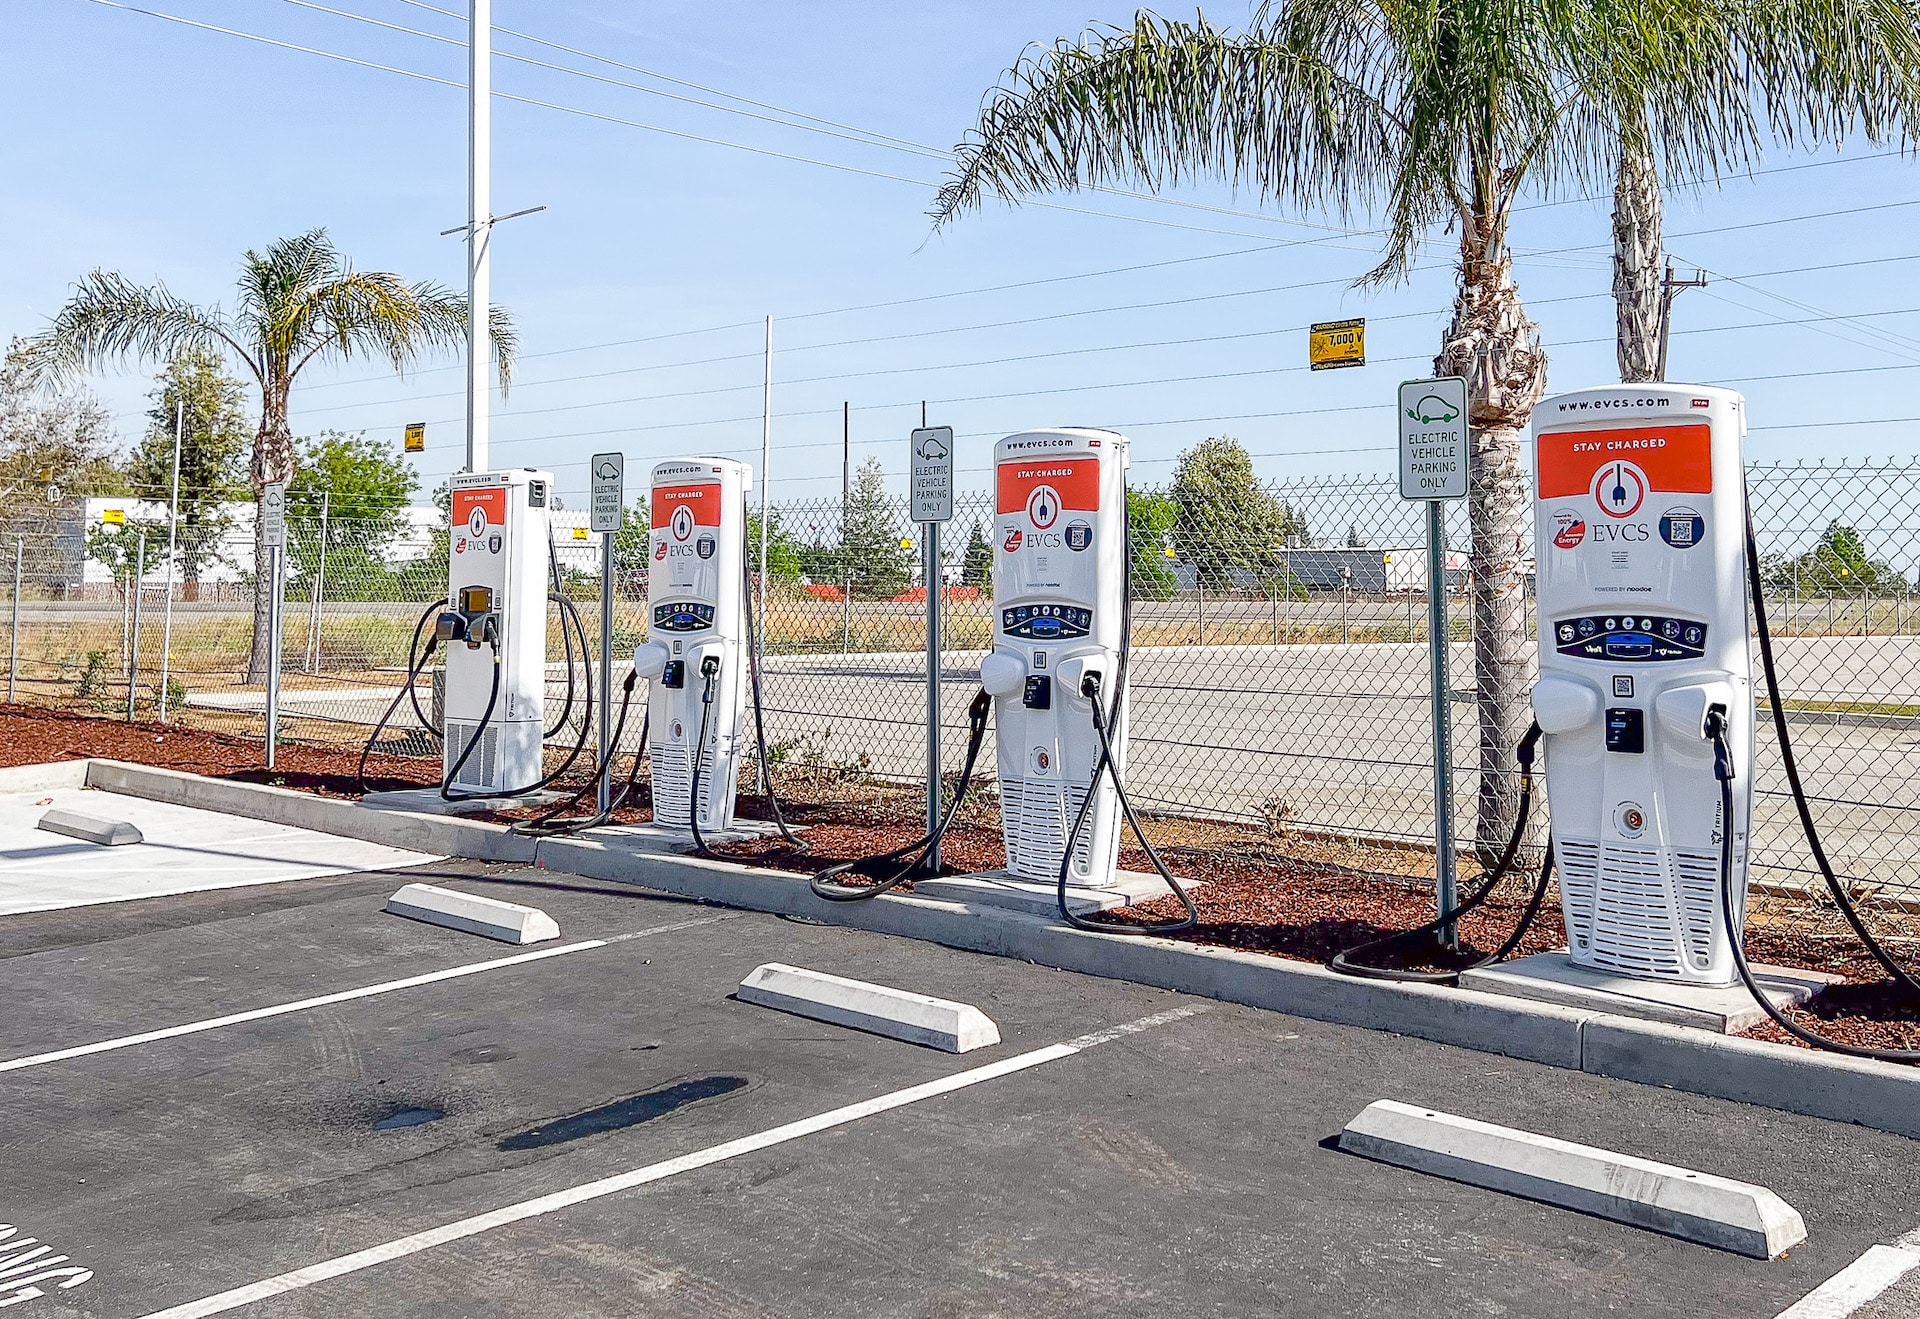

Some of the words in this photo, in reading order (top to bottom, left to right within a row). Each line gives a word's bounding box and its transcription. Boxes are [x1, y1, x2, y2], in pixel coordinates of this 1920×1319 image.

[1330, 333, 1354, 347] 7,000
[1558, 397, 1670, 412] www.evcs.com
[1408, 431, 1458, 445] ELECTRIC
[1007, 440, 1073, 450] www.evcs.com
[1573, 442, 1602, 452] STAY
[1606, 438, 1666, 450] CHARGED
[1411, 447, 1456, 459] VEHICLE
[915, 465, 948, 476] ELECTRIC
[1017, 470, 1034, 479] STAY
[1036, 468, 1073, 477] CHARGED
[1411, 462, 1457, 474] PARKING
[917, 478, 946, 488] VEHICLE
[1420, 477, 1448, 489] ONLY
[594, 485, 619, 494] ELECTRIC
[916, 490, 947, 500] PARKING
[595, 495, 618, 504] VEHICLE
[595, 505, 618, 514] PARKING
[921, 502, 941, 512] ONLY
[1592, 523, 1650, 542] EVCS
[468, 540, 486, 551] EVCS
[1027, 533, 1061, 548] EVCS
[1558, 537, 1580, 545] Energy
[670, 544, 694, 557] EVCS
